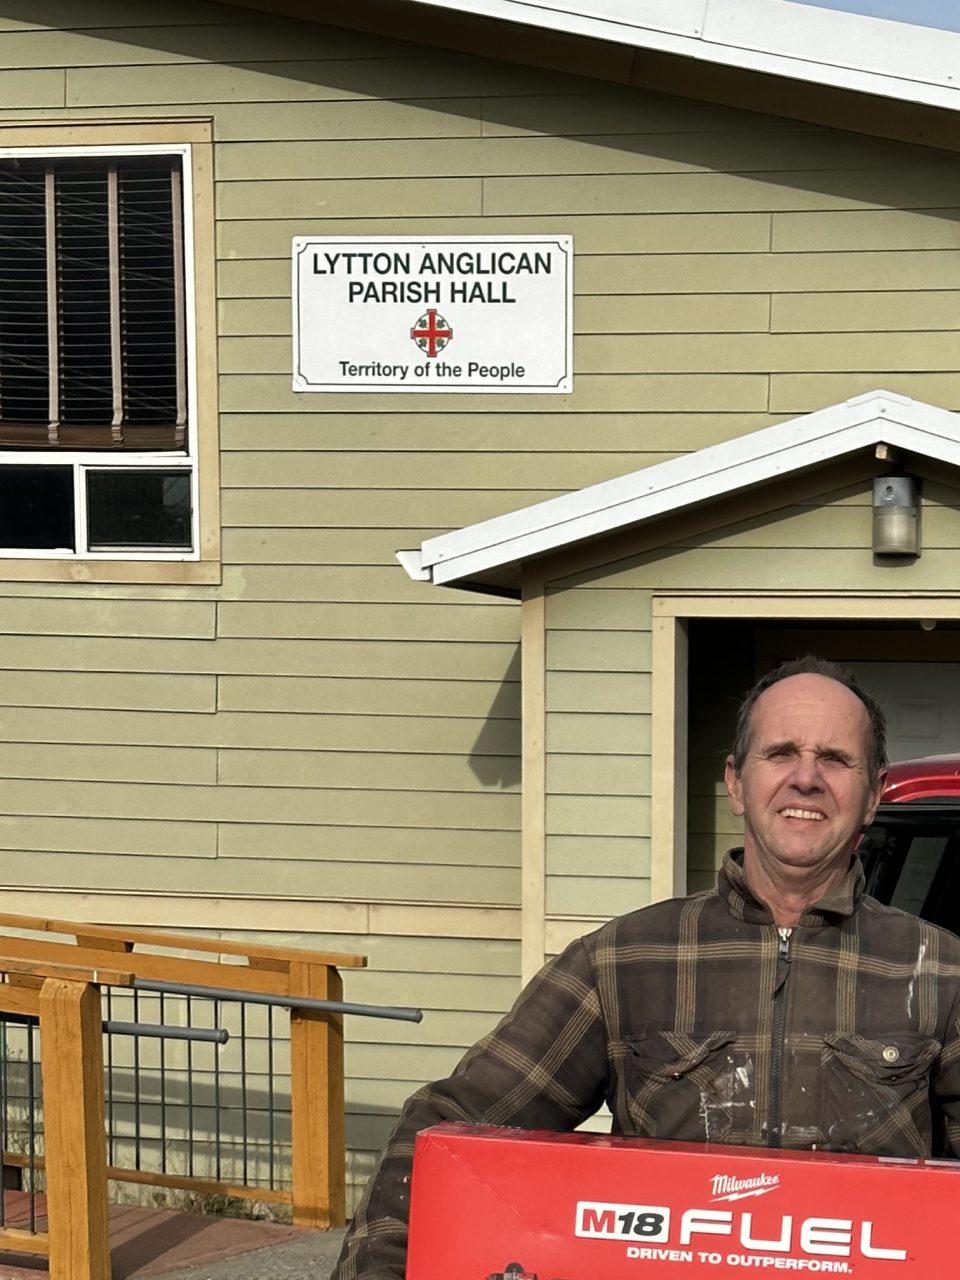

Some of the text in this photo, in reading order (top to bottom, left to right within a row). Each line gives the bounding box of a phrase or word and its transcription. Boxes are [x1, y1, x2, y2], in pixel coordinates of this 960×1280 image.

[313, 252, 551, 275] LYTTON ANGLICAN
[349, 281, 516, 303] PARISH HALL
[339, 361, 526, 381] Territory of the People
[710, 1173, 780, 1196] Milwaukee
[581, 1208, 907, 1261] M18 FUEL
[626, 1247, 693, 1263] DRIVEN
[698, 1251, 722, 1265] TO
